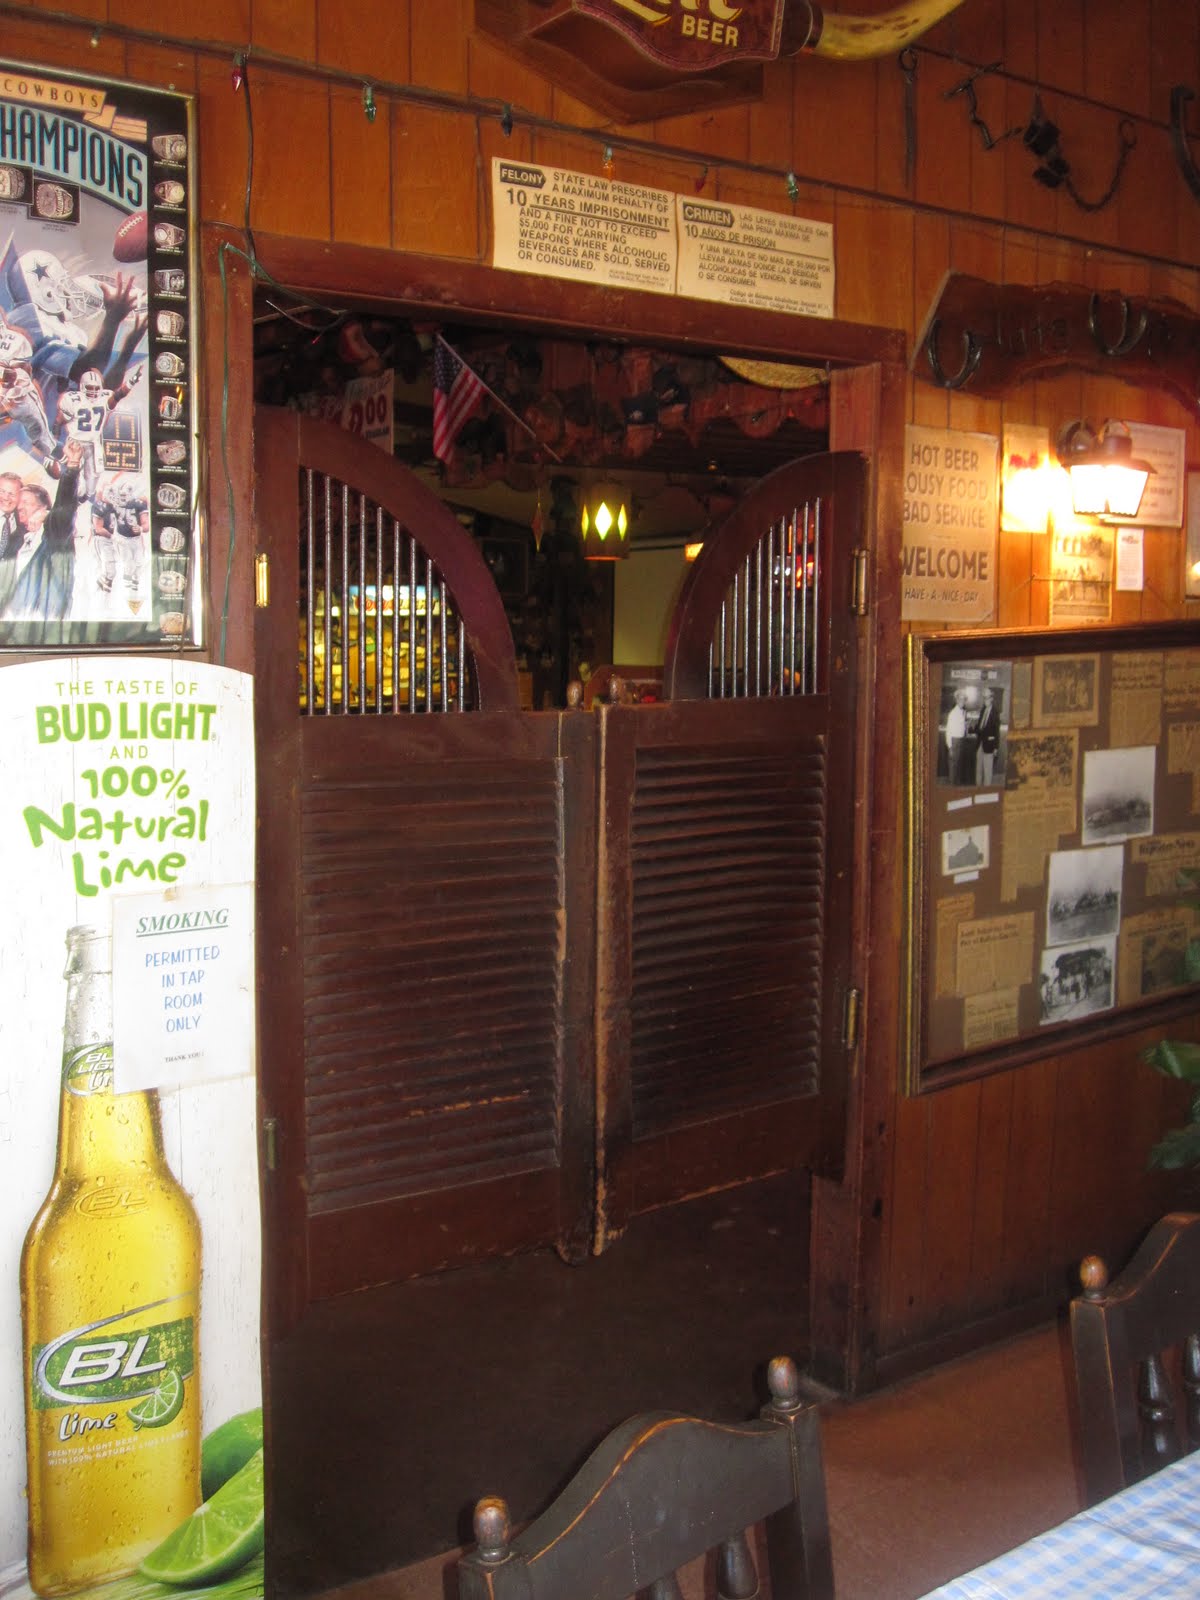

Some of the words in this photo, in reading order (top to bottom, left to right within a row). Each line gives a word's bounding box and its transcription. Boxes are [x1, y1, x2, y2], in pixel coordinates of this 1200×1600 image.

[682, 14, 739, 48] BEER
[4, 78, 99, 108] COWBOYS
[501, 167, 543, 185] FELONY
[553, 171, 585, 187] STATE
[588, 176, 608, 191] LAW
[611, 183, 669, 204] PRESCRIBES
[506, 187, 528, 207] 10
[534, 192, 576, 210] YEARS
[579, 201, 670, 228] IMPRISONMENT
[552, 183, 559, 193] A
[562, 184, 610, 202] MAXIMUM
[612, 193, 654, 210] PENALTY
[656, 202, 669, 213] OF
[519, 207, 541, 219] AND
[545, 211, 552, 221] A
[555, 213, 577, 225] FINE
[580, 216, 600, 228] NOT
[605, 221, 618, 232] TO
[620, 224, 658, 240] EXCEED
[684, 205, 732, 226] CRIMEN
[739, 212, 753, 222] LAS
[755, 215, 776, 227] LEYES
[519, 218, 549, 231] $5,000
[553, 223, 573, 234] FOR
[576, 226, 627, 244] CARRYING
[685, 223, 699, 239] 10
[728, 232, 740, 242] DE
[518, 239, 579, 258] BEVERAGES
[581, 249, 600, 261] ARE
[604, 253, 632, 268] SOLD,
[634, 257, 671, 272] SERVED
[519, 228, 570, 245] WEAPONS
[573, 236, 608, 251] WHERE
[612, 244, 668, 262] ALCOHOLIC
[700, 243, 704, 251] Y
[706, 244, 721, 254] UNA
[722, 246, 746, 259] MULTA
[748, 250, 757, 260] DE
[758, 252, 768, 262] NO
[518, 250, 533, 261] OR
[536, 252, 596, 271] CONSUMED.
[699, 252, 726, 264] LLEVAR
[727, 256, 752, 269] ARMAS
[753, 261, 777, 273] DONDE
[778, 265, 791, 275] LAS
[698, 271, 703, 279] O
[706, 272, 716, 281] SE
[749, 270, 758, 279] SE
[789, 276, 798, 286] SE
[799, 277, 822, 290] SIRVEN
[77, 406, 105, 432] 27
[106, 442, 135, 467] 52
[911, 444, 940, 467] HOT
[944, 447, 979, 472] BEER
[904, 472, 943, 496] OUSY
[949, 476, 989, 501] FOOD
[902, 499, 931, 523] BAD
[935, 502, 986, 528] SERVICE
[56, 680, 94, 697] THE
[105, 679, 165, 695] TASTE
[175, 681, 199, 696] OF
[35, 702, 112, 744] BUD
[119, 701, 217, 741] LIGHT
[110, 745, 149, 759] AND
[81, 765, 190, 800] 100%
[22, 799, 209, 848] Natural
[72, 851, 187, 897] Lime
[136, 908, 230, 934] SMOKING
[145, 945, 221, 968] PERMITTED
[161, 974, 175, 988] IN
[179, 969, 205, 987] TAP
[164, 992, 203, 1011] ROOM
[166, 1015, 202, 1034] ONLY
[77, 1062, 113, 1074] LIG
[164, 1055, 187, 1063] THANK
[58, 1335, 167, 1387] BL
[58, 1412, 118, 1441] Lime
[47, 1447, 85, 1458] PREMIUM
[87, 1441, 112, 1452] LIGHT
[115, 1436, 139, 1447] BEER
[48, 1458, 68, 1466] WITH
[96, 1446, 137, 1459] NATURAL
